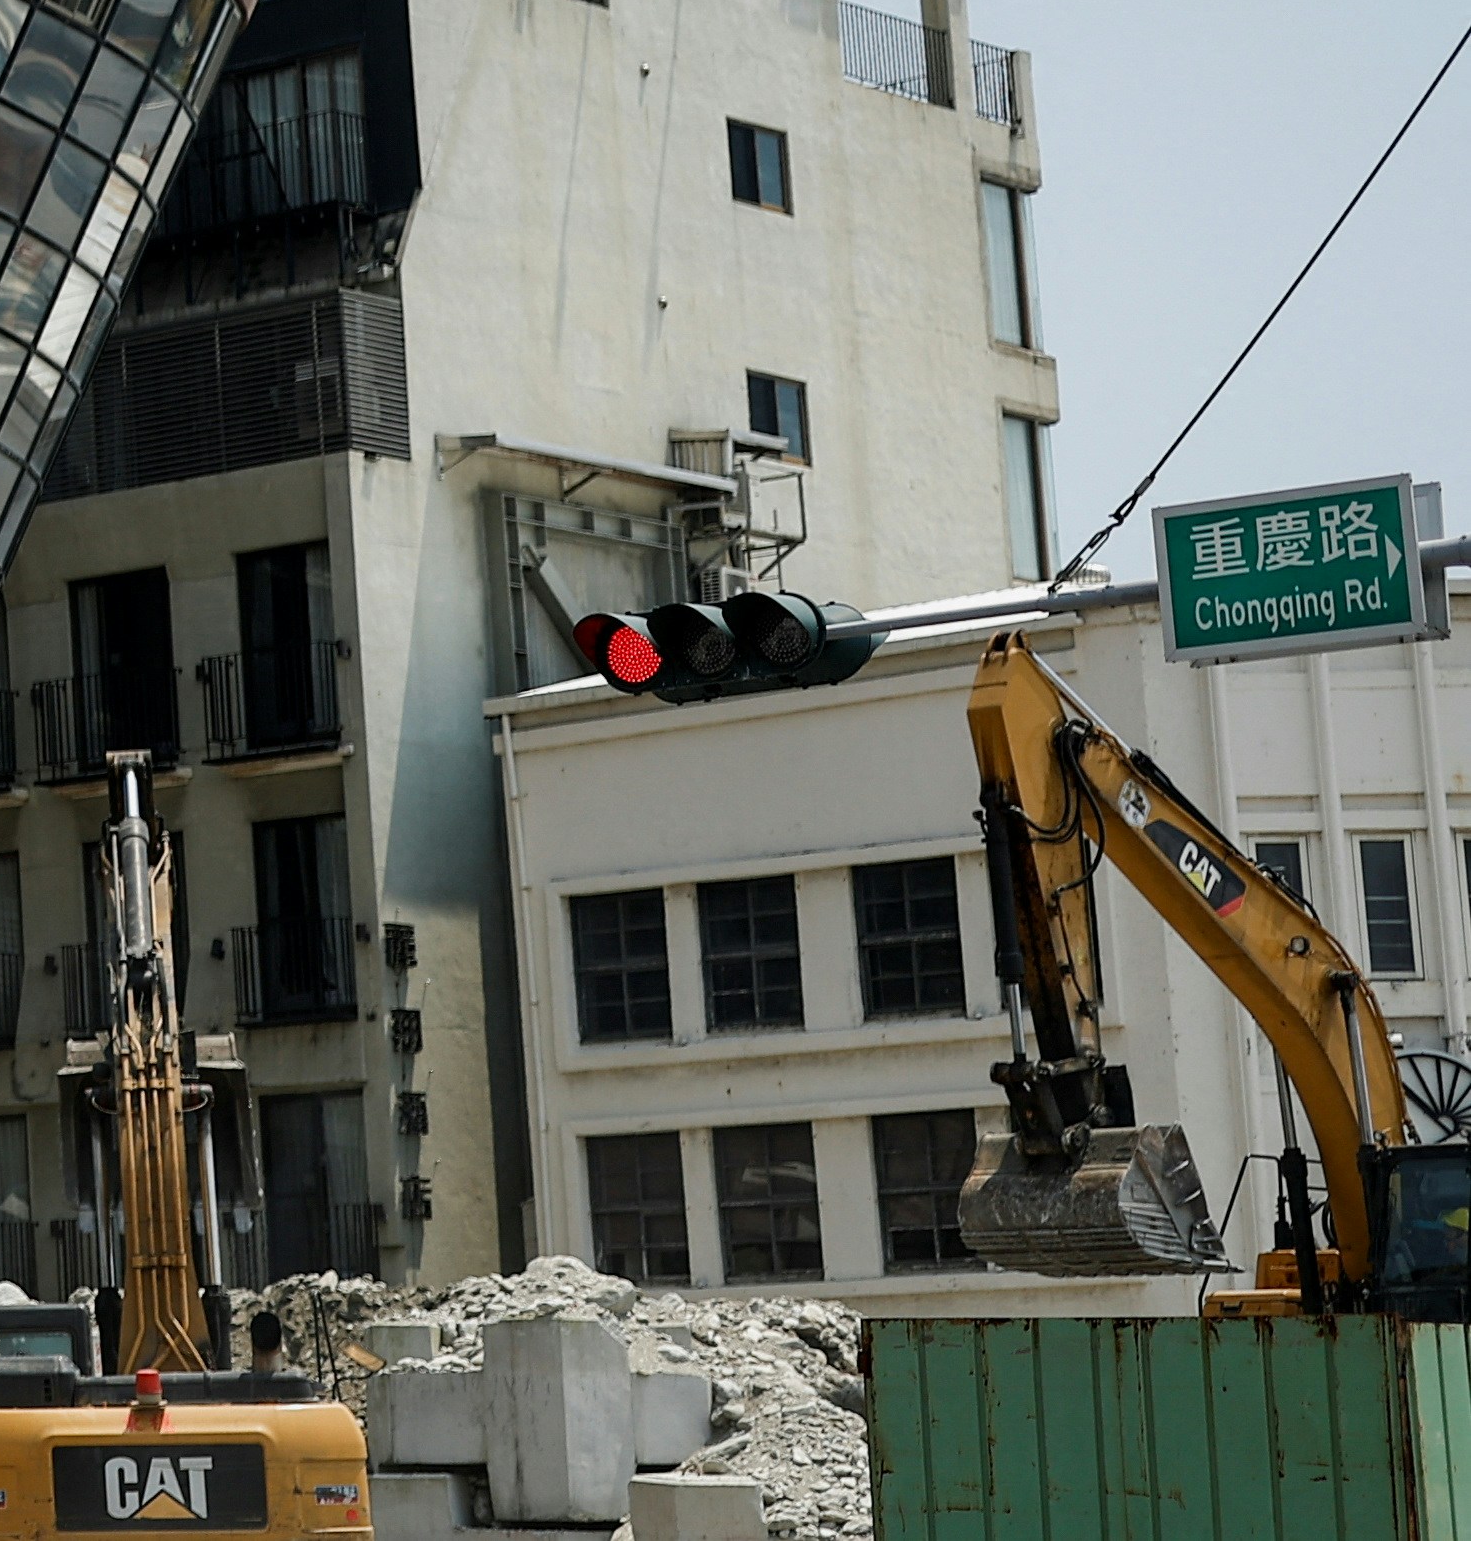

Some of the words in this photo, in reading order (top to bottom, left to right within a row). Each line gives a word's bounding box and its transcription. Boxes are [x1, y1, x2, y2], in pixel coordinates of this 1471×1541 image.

[1189, 500, 1379, 581] 重慶路
[1195, 585, 1336, 633] Chongqing
[1344, 576, 1388, 613] Rd.
[1179, 840, 1222, 899] CAT
[104, 1456, 213, 1520] CAT
